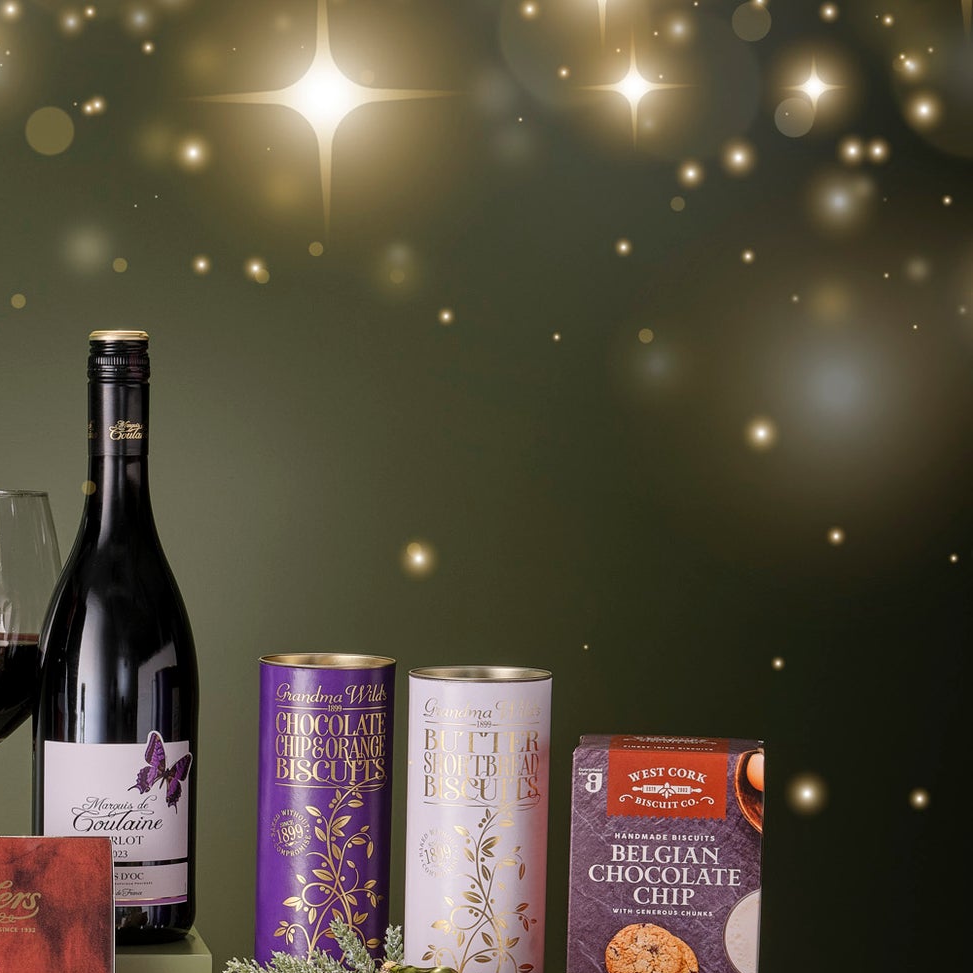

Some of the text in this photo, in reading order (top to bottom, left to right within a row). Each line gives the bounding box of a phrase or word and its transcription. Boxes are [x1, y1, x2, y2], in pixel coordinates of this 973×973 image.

[275, 682, 342, 704] Grandma
[328, 704, 342, 712] 1899
[276, 712, 386, 737] CHOCOLATE
[425, 729, 539, 753] BUTTER
[276, 759, 386, 783] BISCUITS
[424, 752, 539, 776] SHORTBREAD
[628, 768, 707, 784] WEST CORK
[424, 775, 540, 801] BISCUITS
[635, 797, 678, 808] BISCUIT
[72, 807, 163, 832] Coulaine
[281, 810, 310, 828] WITHOUT
[112, 836, 144, 845] RLOT
[277, 824, 303, 843] 1899
[113, 850, 128, 858] 023
[611, 845, 720, 864] BELGIAN
[589, 864, 741, 886] CHOCOLATE
[634, 887, 694, 905] CHIP
